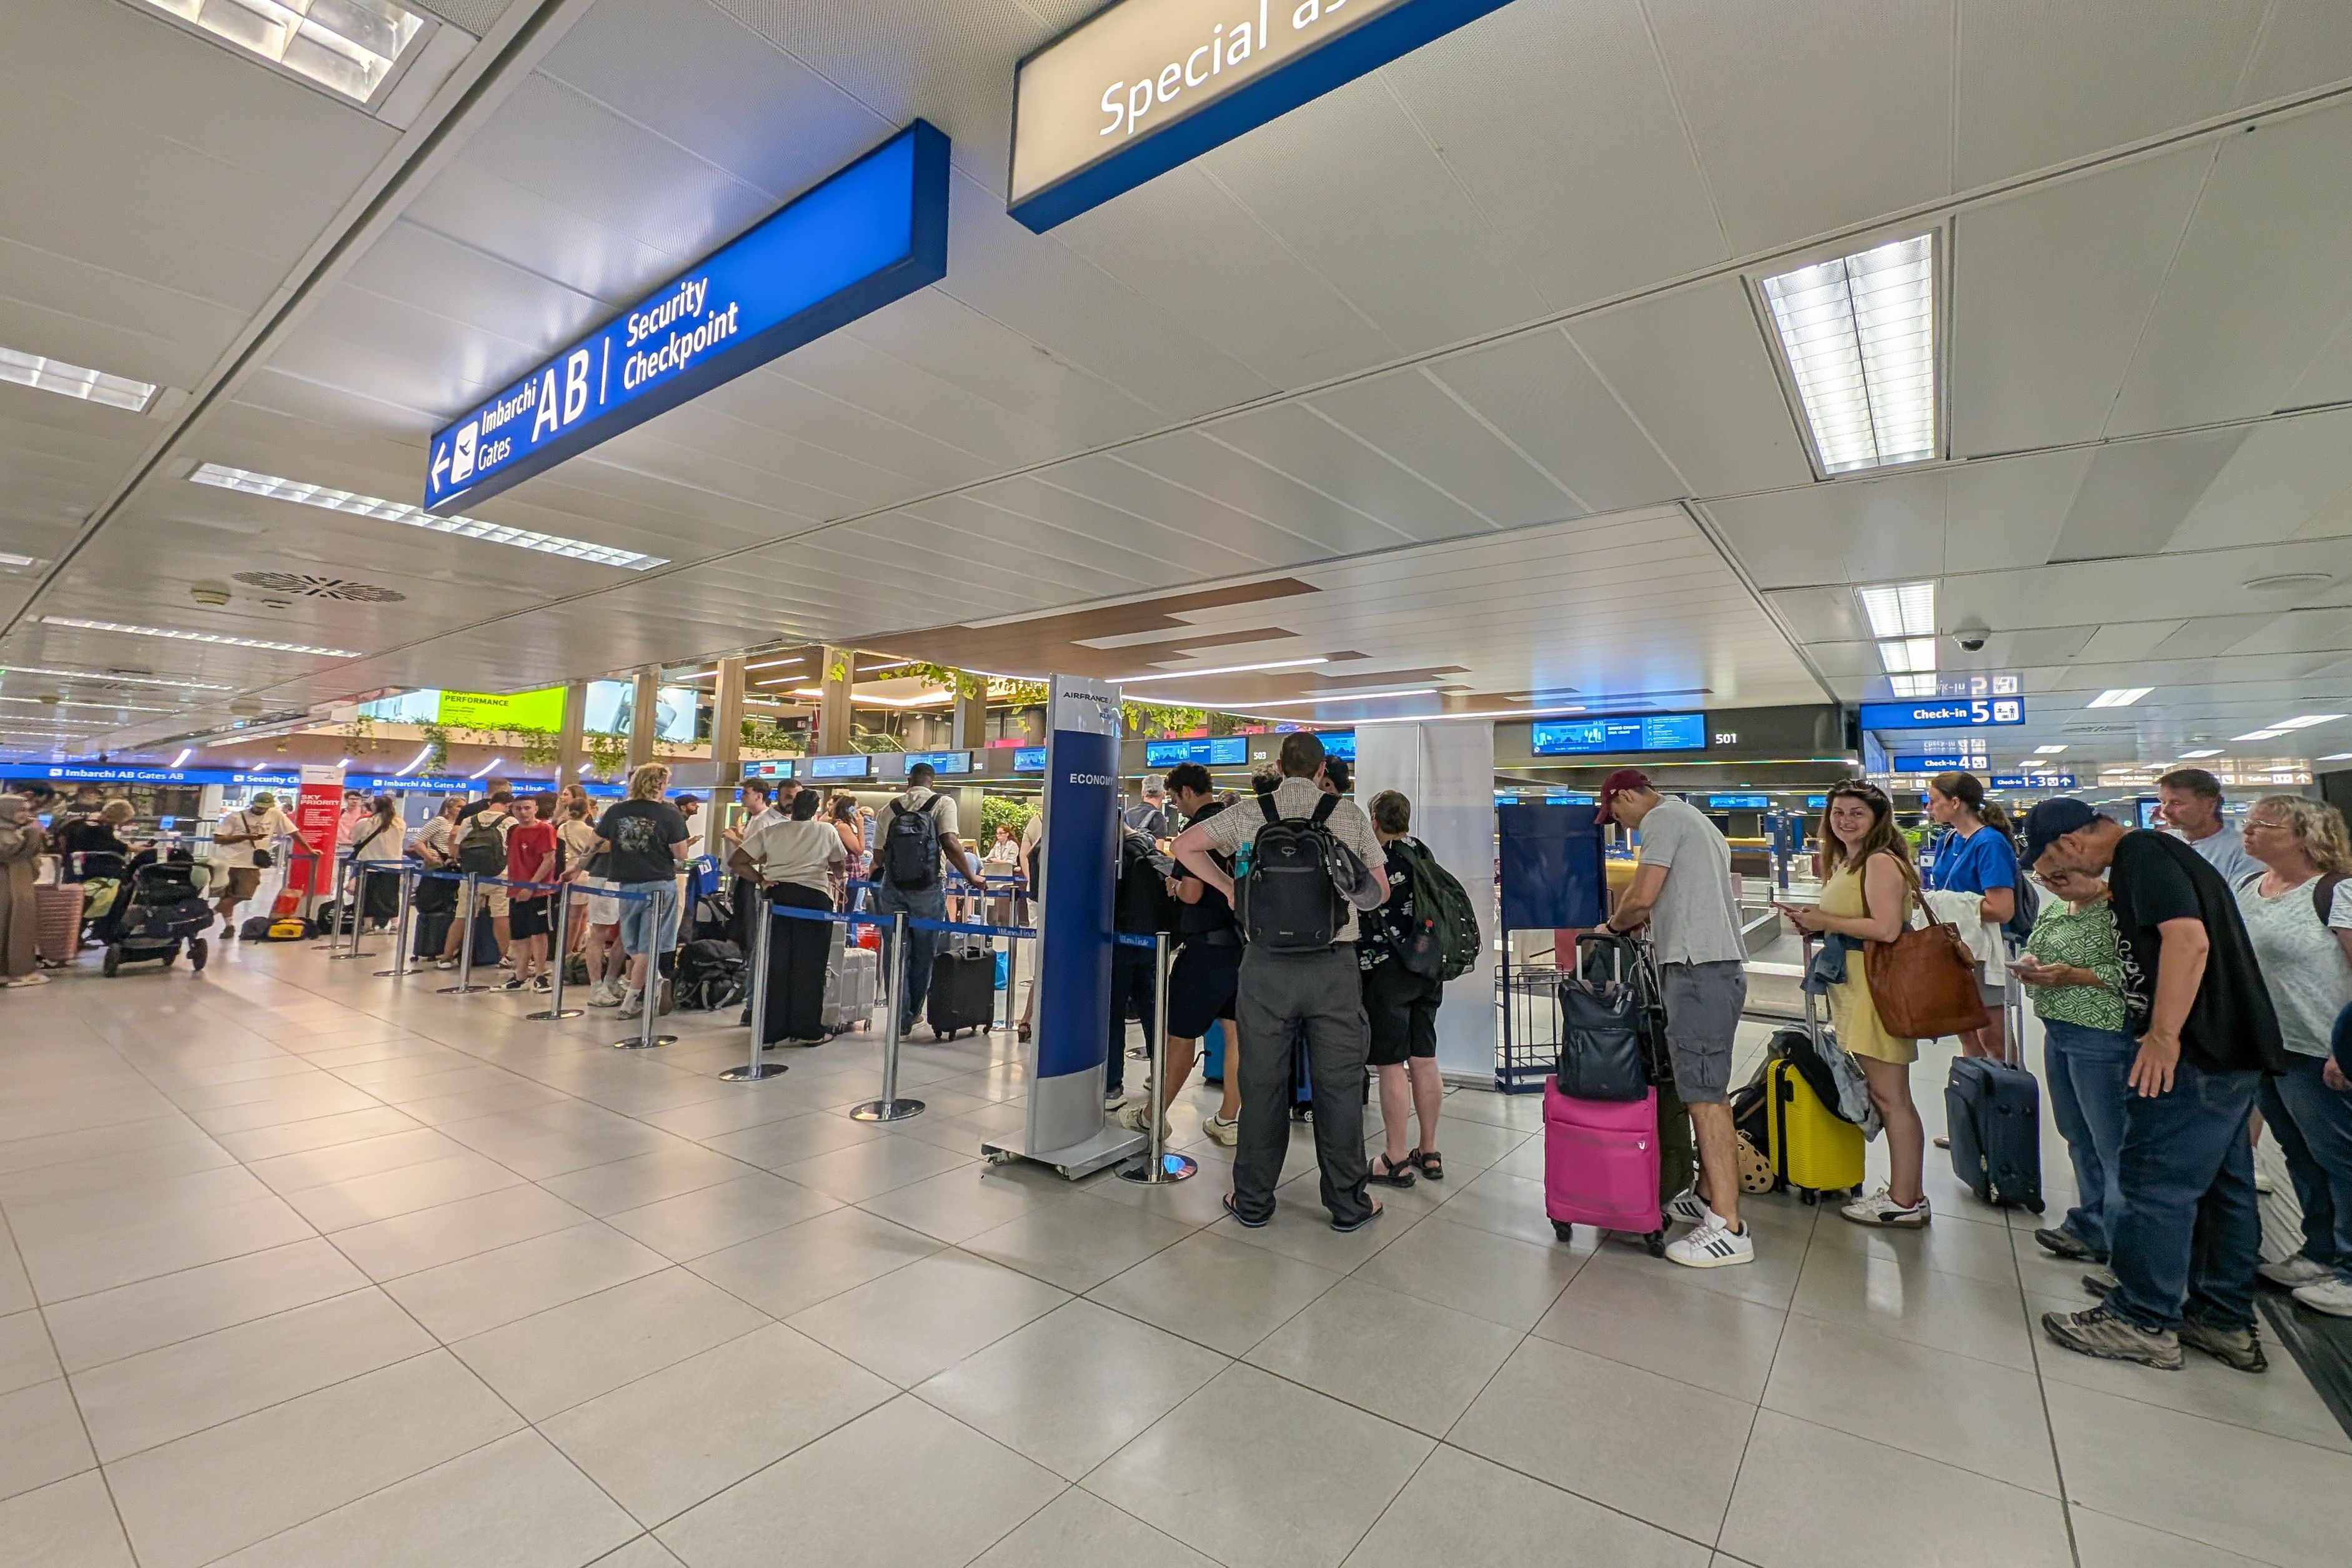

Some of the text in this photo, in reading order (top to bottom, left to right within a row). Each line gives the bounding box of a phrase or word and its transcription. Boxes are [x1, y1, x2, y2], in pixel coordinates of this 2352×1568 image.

[1099, 0, 1268, 135] Special
[627, 277, 708, 347] Security
[623, 302, 738, 389] Checkpoint
[531, 350, 589, 443] AB
[481, 378, 537, 436] Imbarchi
[478, 437, 511, 471] Gates
[445, 695, 509, 707] PERFORMANCE
[1063, 692, 1109, 703] AIRFRANCE
[1913, 701, 1990, 723] Check-in 5
[1715, 733, 1737, 743] 501
[1254, 752, 1267, 760] 503
[1958, 756, 1970, 769] 4
[65, 769, 115, 778] Imbarchi
[247, 775, 285, 785] Security
